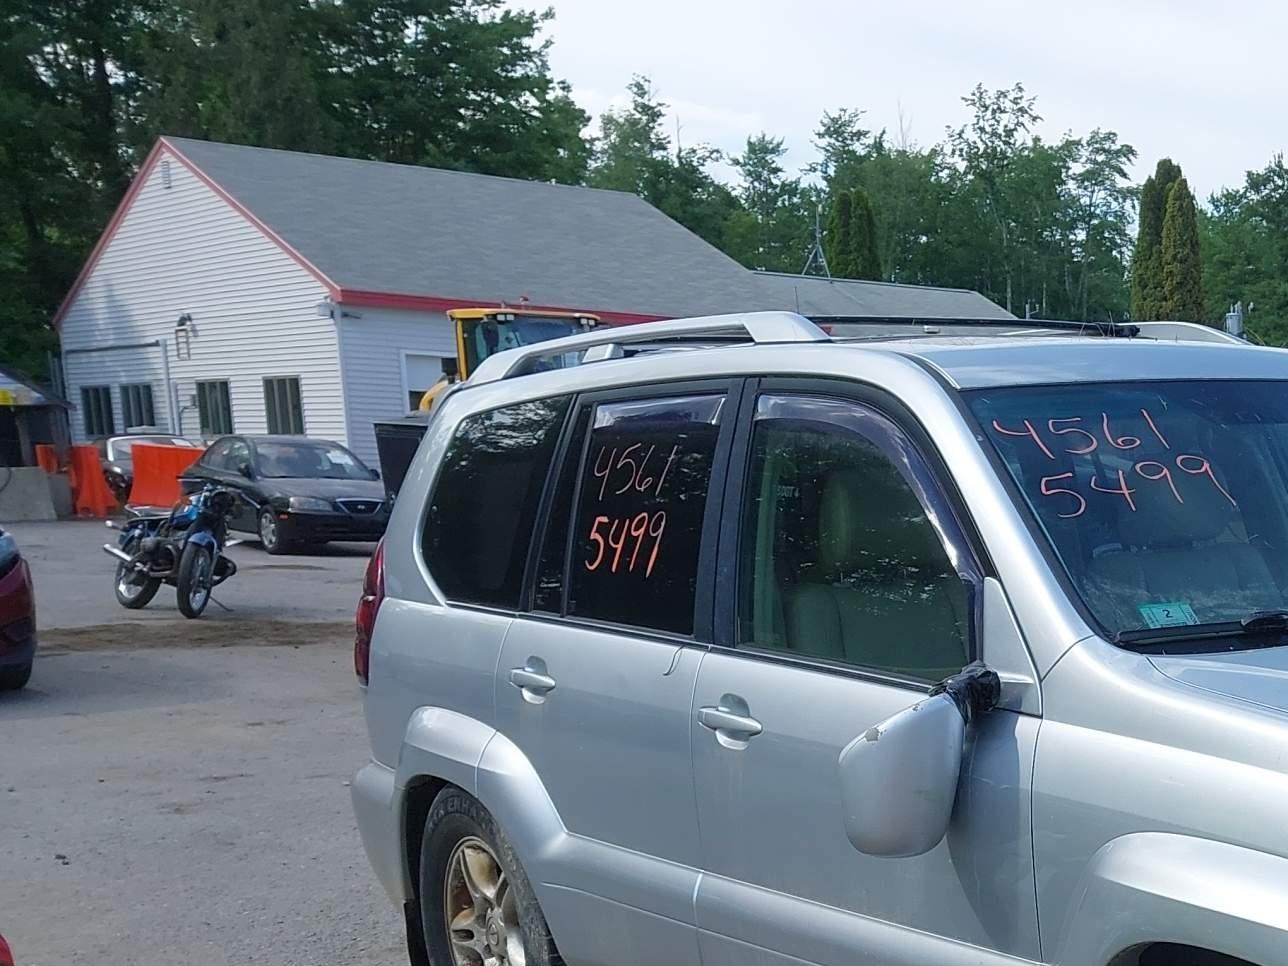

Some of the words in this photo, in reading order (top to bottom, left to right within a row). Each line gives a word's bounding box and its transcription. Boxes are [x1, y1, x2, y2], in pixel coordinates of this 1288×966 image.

[992, 408, 1171, 460] 4561
[592, 442, 679, 501] 4561
[1040, 454, 1238, 518] 5499
[585, 510, 667, 579] 5499
